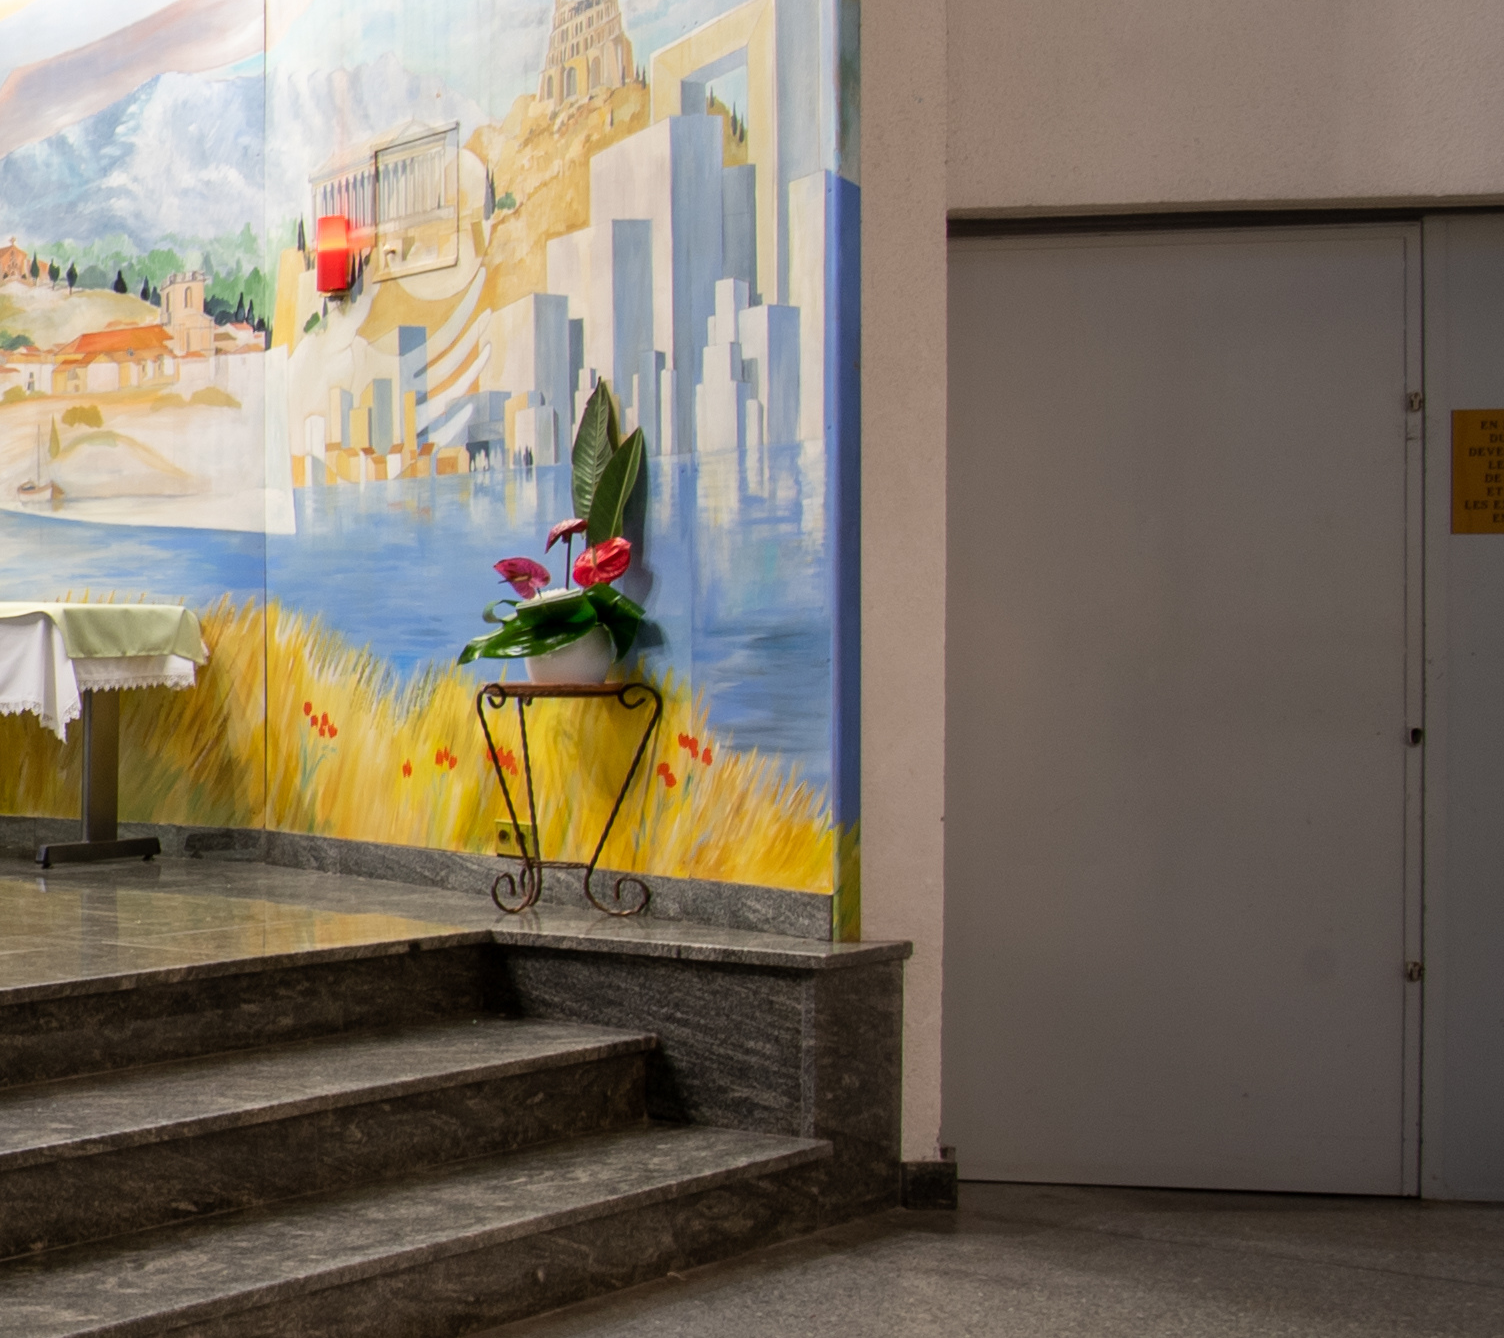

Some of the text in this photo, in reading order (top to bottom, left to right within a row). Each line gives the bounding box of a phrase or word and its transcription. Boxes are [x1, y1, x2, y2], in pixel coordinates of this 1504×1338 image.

[1481, 421, 1498, 430] EN
[1484, 473, 1502, 483] DE
[1486, 487, 1503, 497] ET
[1464, 500, 1488, 510] LES
